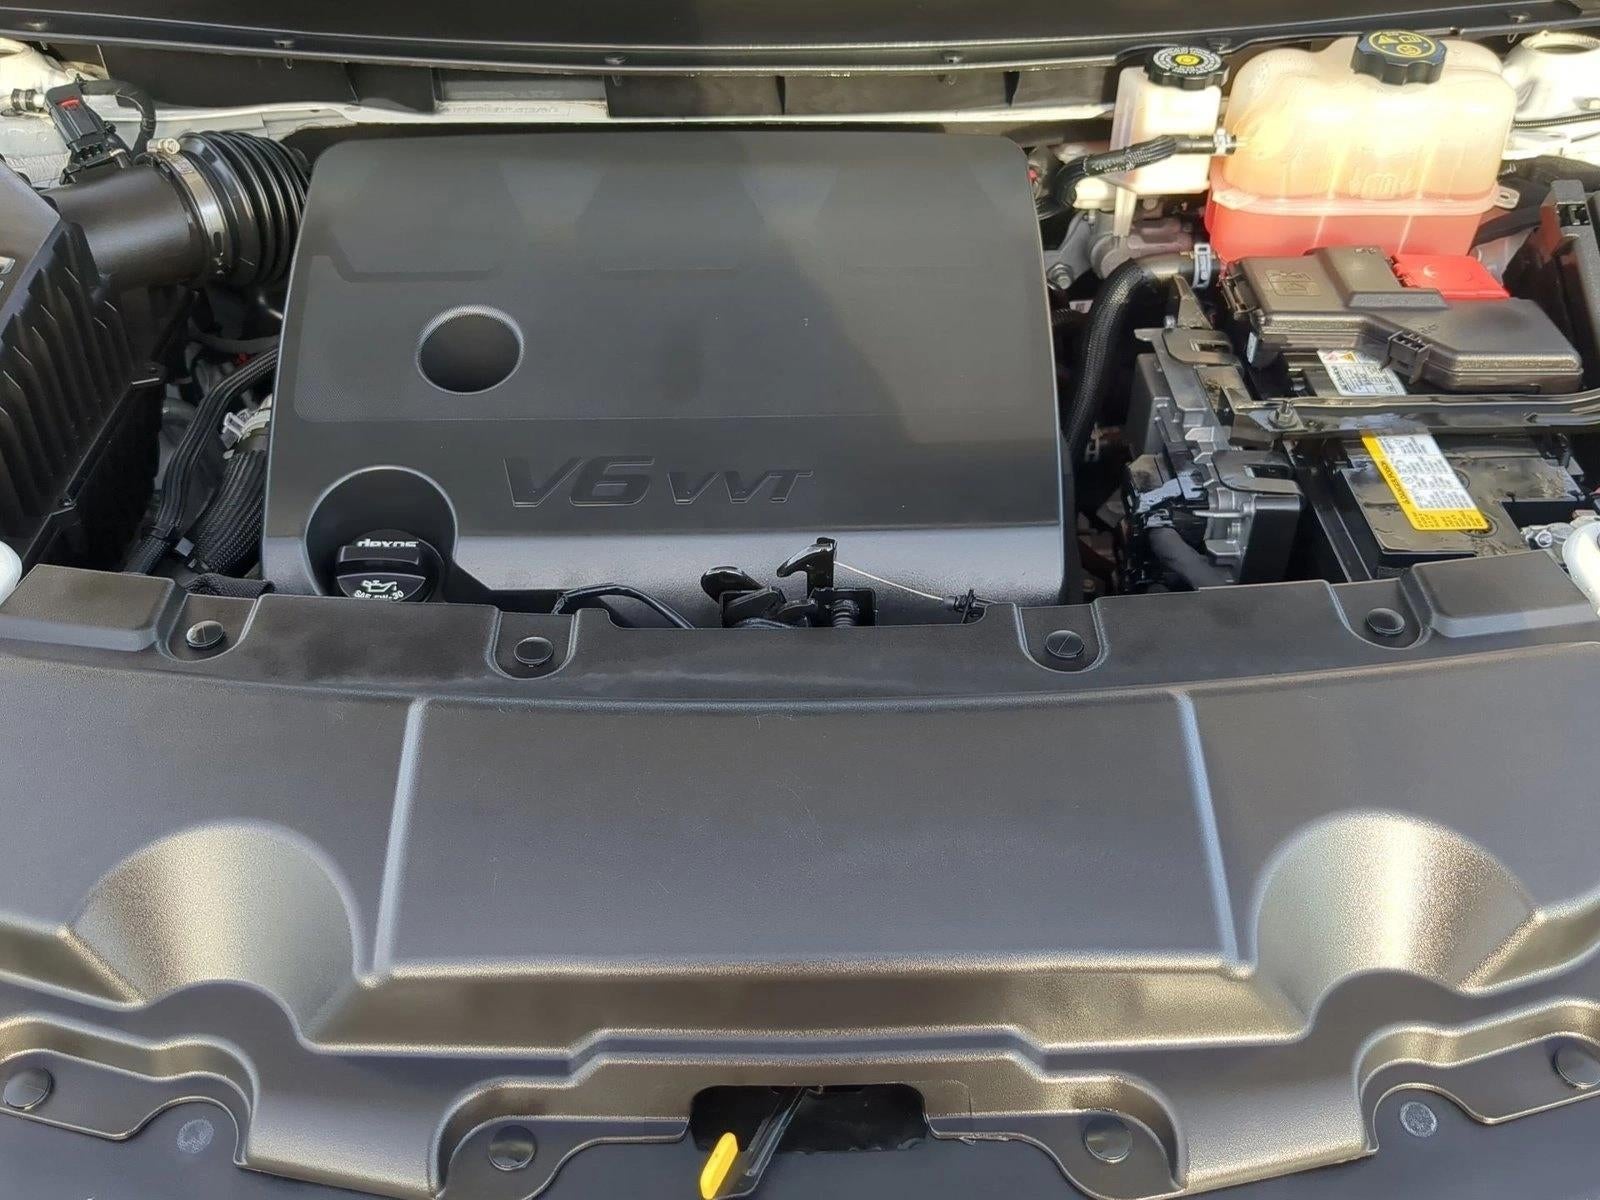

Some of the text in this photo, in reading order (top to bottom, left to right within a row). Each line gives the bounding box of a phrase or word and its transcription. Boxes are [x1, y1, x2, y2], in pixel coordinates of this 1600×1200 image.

[503, 456, 814, 507] V6 VVT
[354, 589, 371, 599] SAE
